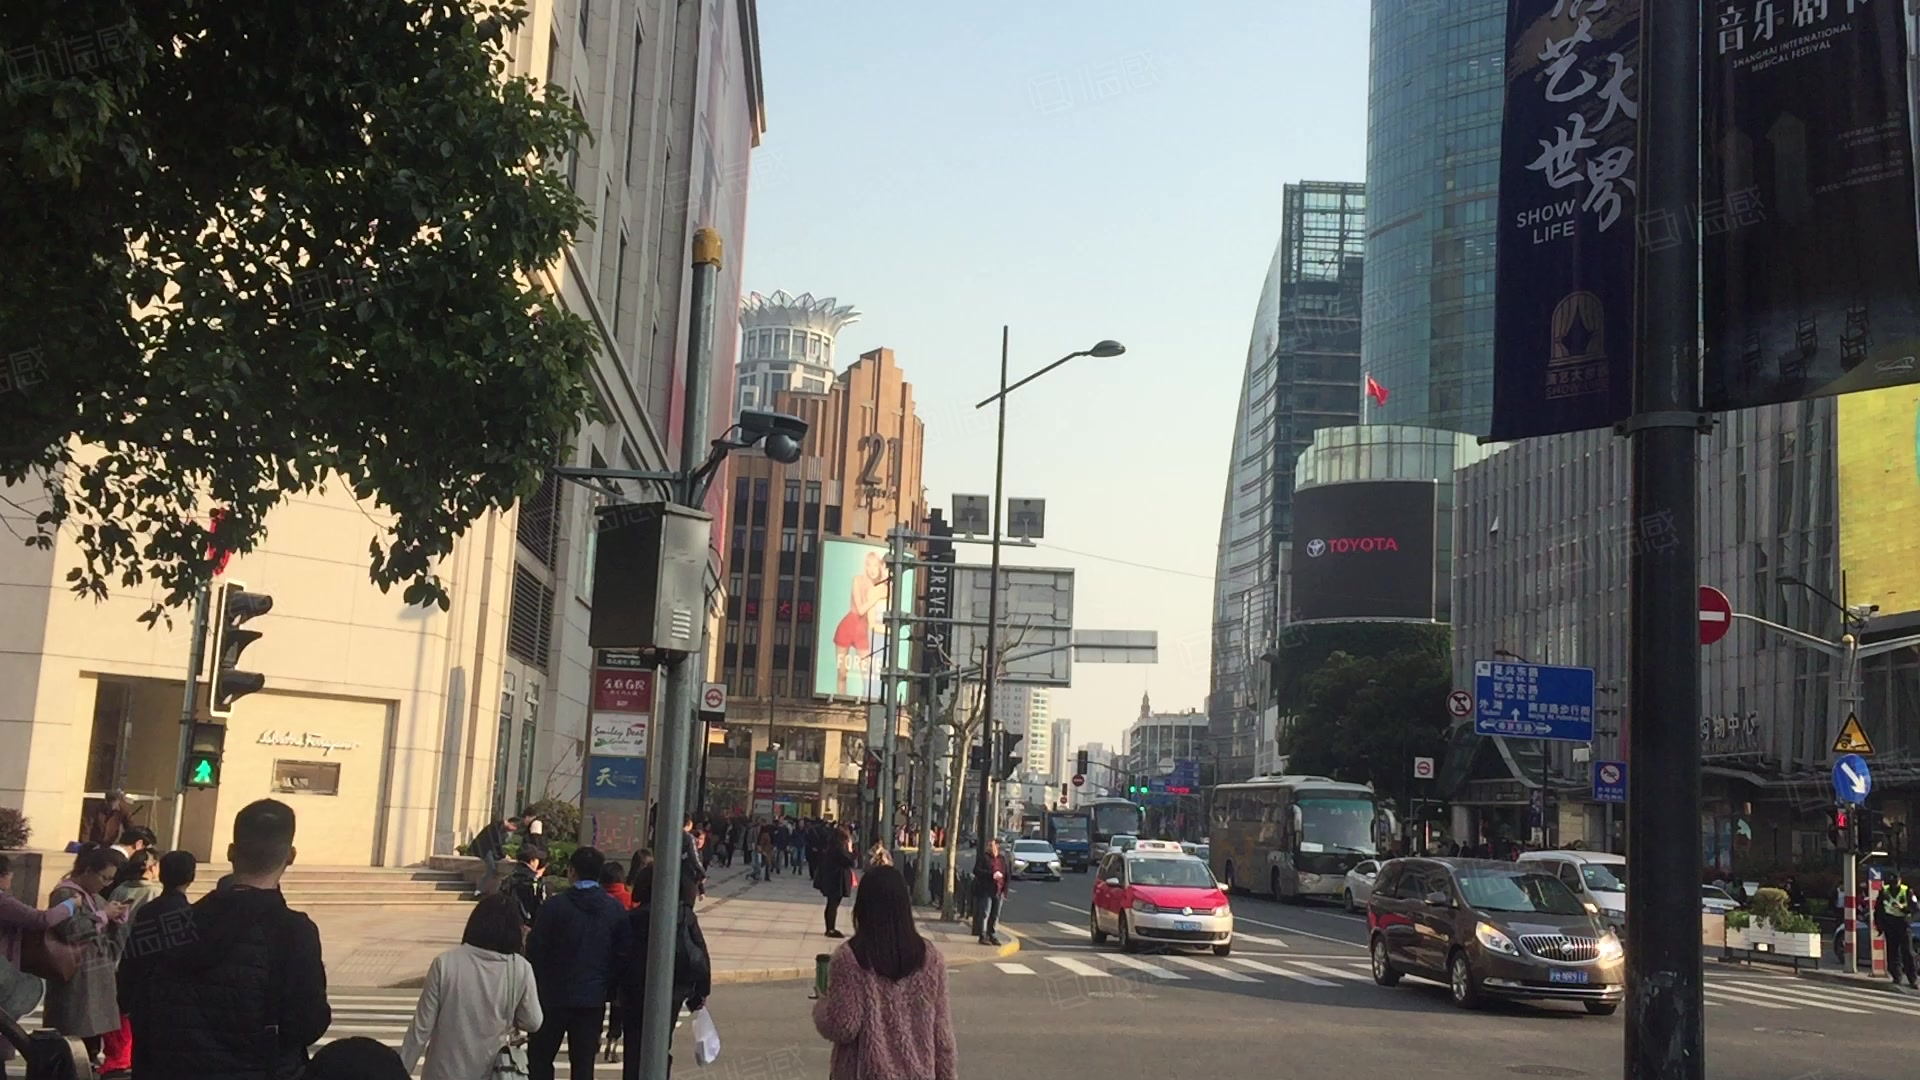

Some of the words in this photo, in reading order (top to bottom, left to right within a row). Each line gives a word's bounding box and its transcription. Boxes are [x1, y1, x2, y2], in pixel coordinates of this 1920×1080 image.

[1717, 0, 1868, 54] 音乐剧
[1732, 44, 1778, 68] SHANGHAI
[1777, 23, 1852, 53] INTERNATIONAL
[1751, 54, 1789, 73] MUSICAL
[1791, 39, 1832, 59] FESTIVAL
[1516, 199, 1577, 229] SHOW
[1533, 219, 1576, 245] LIFE
[1327, 537, 1398, 553] TOYOTA
